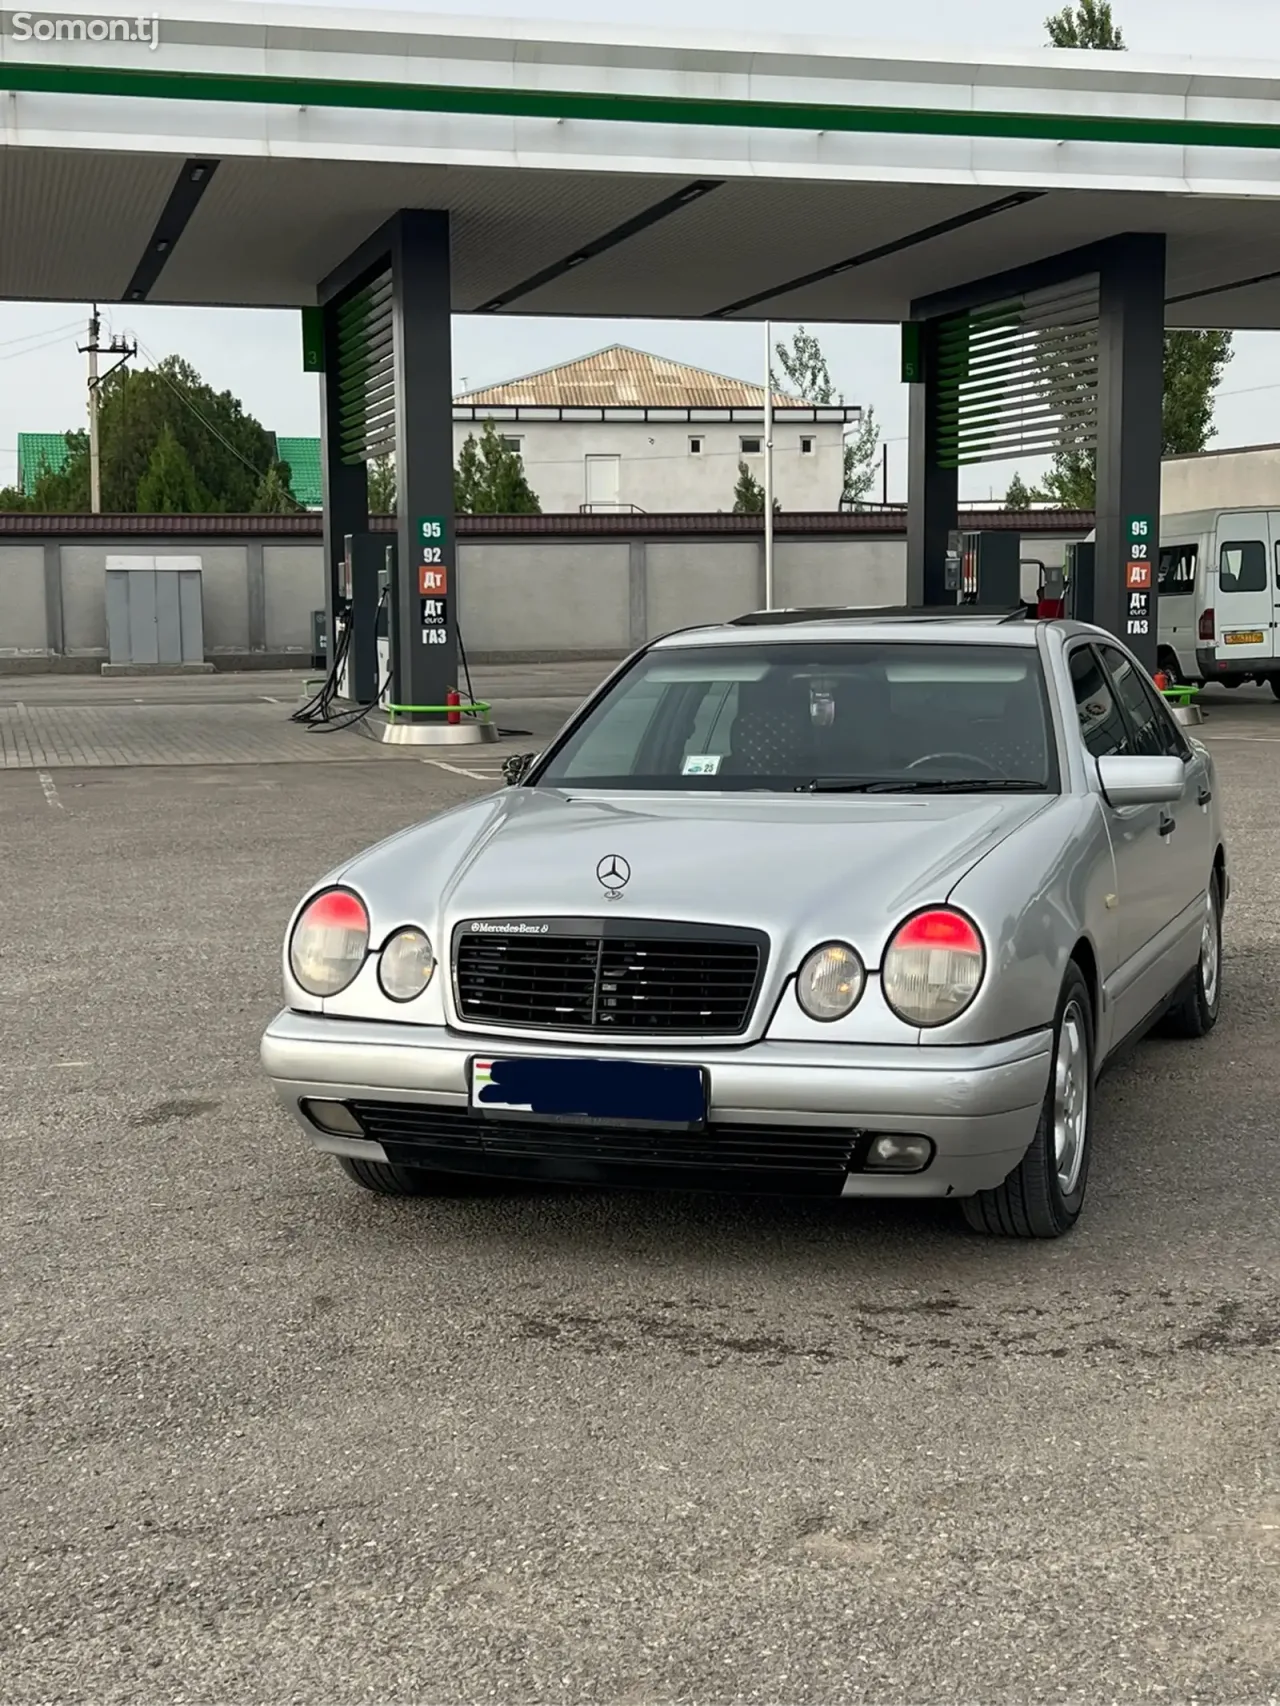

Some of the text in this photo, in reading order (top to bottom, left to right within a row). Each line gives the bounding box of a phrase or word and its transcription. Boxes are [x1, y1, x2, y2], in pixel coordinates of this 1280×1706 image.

[308, 350, 317, 365] 3
[906, 363, 914, 376] 5
[422, 522, 442, 538] 95
[1131, 521, 1148, 536] 95
[423, 547, 442, 563] 92
[1131, 544, 1147, 559] 92
[423, 571, 443, 589] Дт
[1130, 567, 1148, 584] Дт
[1130, 592, 1147, 609] Дт
[424, 600, 444, 617] Дт
[424, 617, 444, 625] euro
[1127, 620, 1149, 635] ГАЗ
[422, 629, 447, 644] ГАЗ
